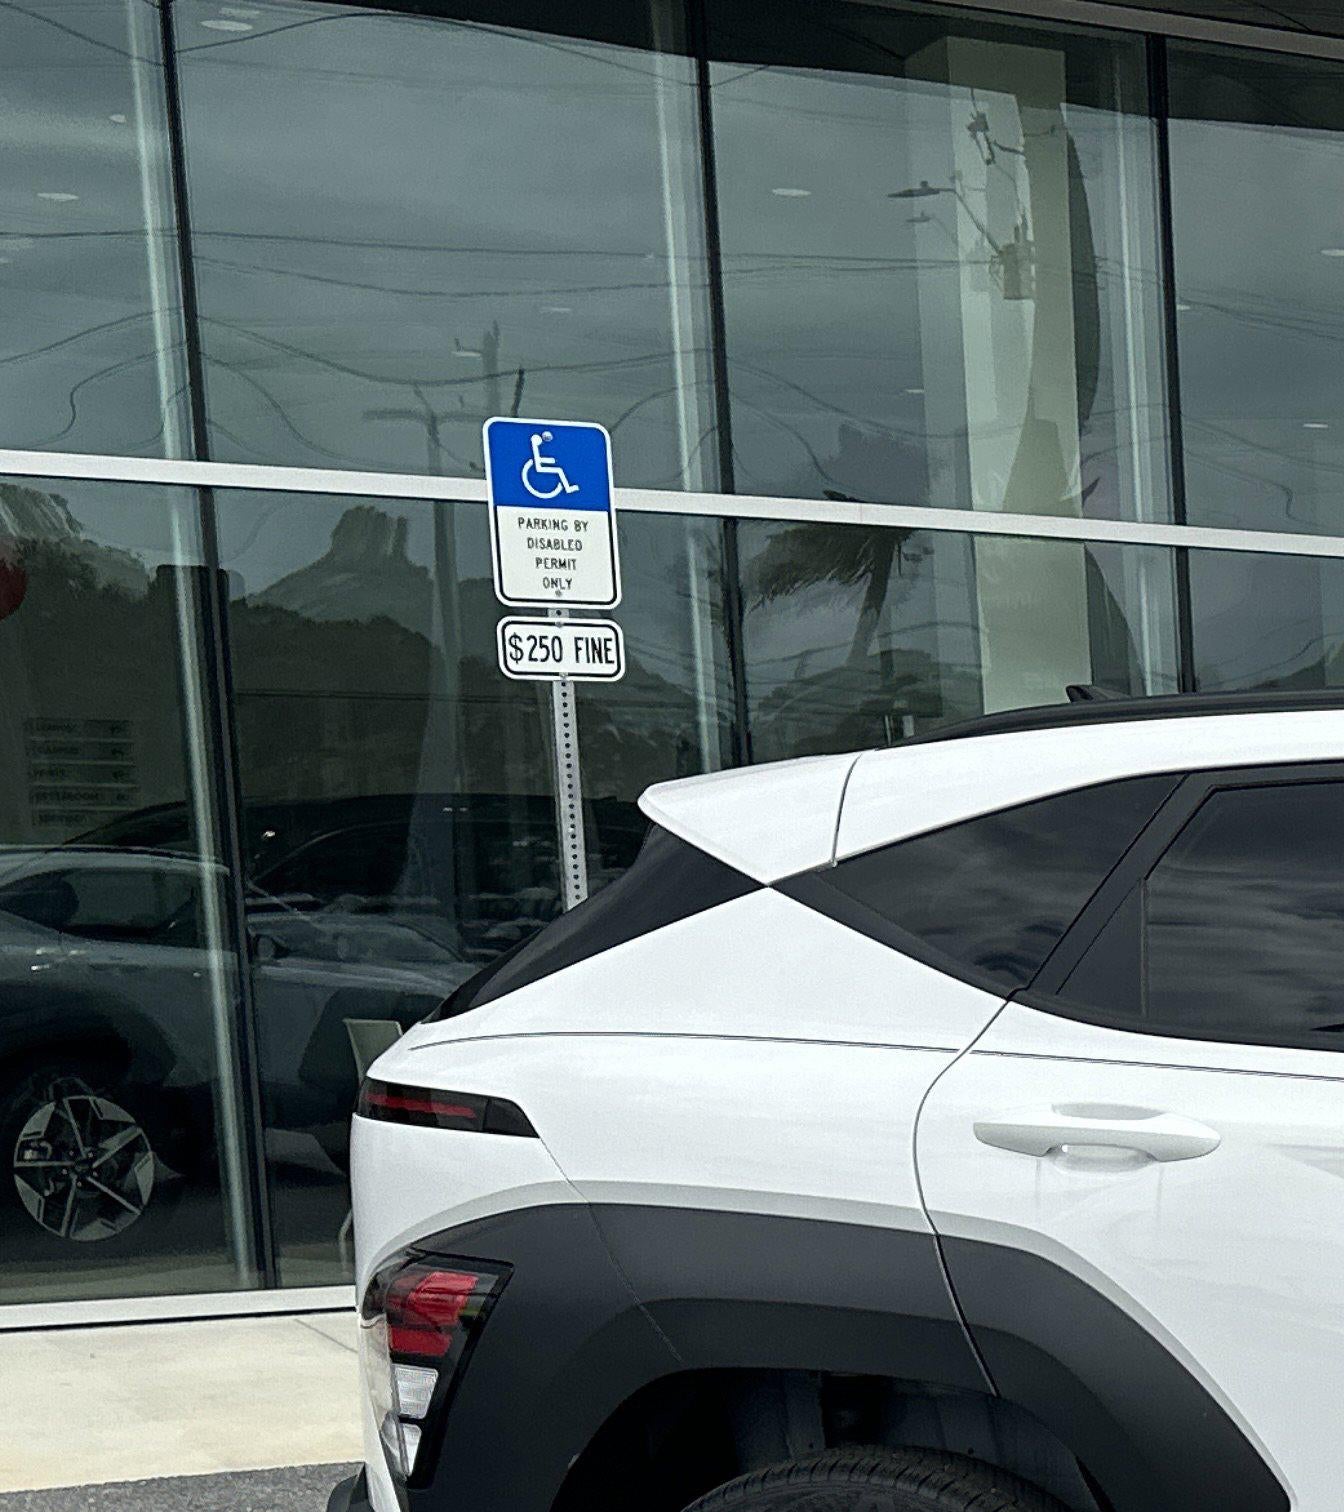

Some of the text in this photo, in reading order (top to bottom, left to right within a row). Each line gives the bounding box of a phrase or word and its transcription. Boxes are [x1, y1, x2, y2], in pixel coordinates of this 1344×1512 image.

[517, 516, 589, 533] PARKING BY
[526, 536, 583, 552] DISABLED
[535, 556, 577, 571] PERMIT
[542, 576, 573, 591] ONLY
[508, 632, 615, 664] $250 FINE
